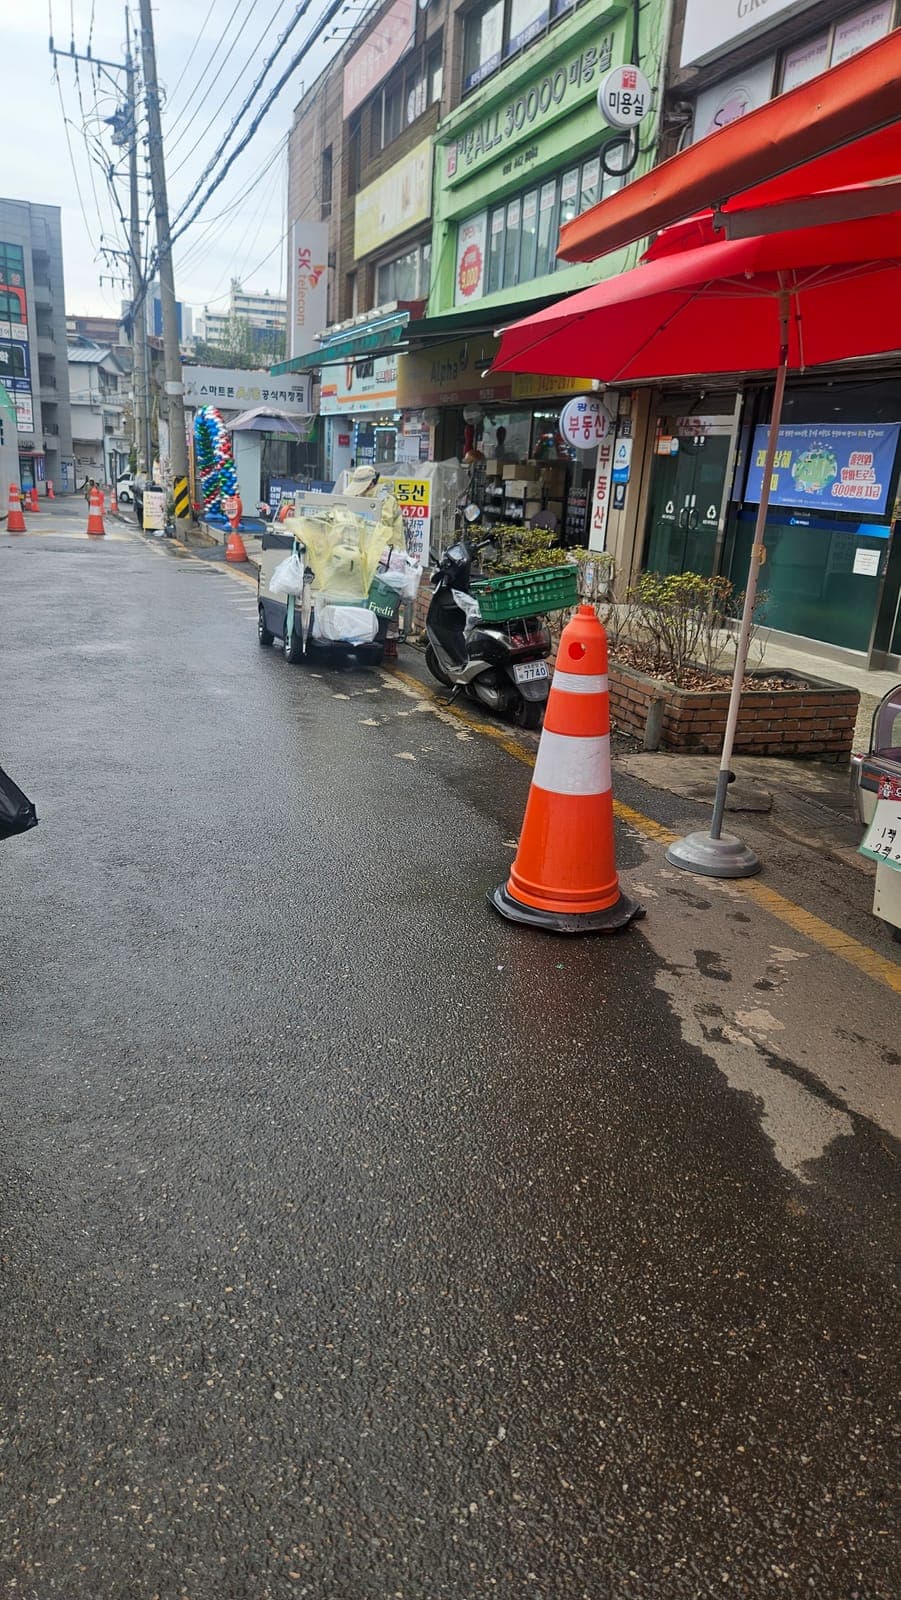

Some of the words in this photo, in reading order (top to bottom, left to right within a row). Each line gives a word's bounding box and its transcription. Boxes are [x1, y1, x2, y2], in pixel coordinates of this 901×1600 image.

[474, 111, 502, 159] ALL
[568, 32, 616, 88] 미용실
[608, 91, 645, 117] 미용실
[298, 247, 311, 270] SK
[297, 274, 308, 326] telecom
[199, 385, 235, 398] 스마트폰
[262, 389, 304, 403] 공식지정점
[568, 415, 606, 440] 부동산
[396, 483, 426, 502] 동산
[593, 445, 611, 529] 부동산
[402, 506, 425, 518] 670
[369, 601, 395, 617] Fredit
[524, 667, 546, 679] 7740
